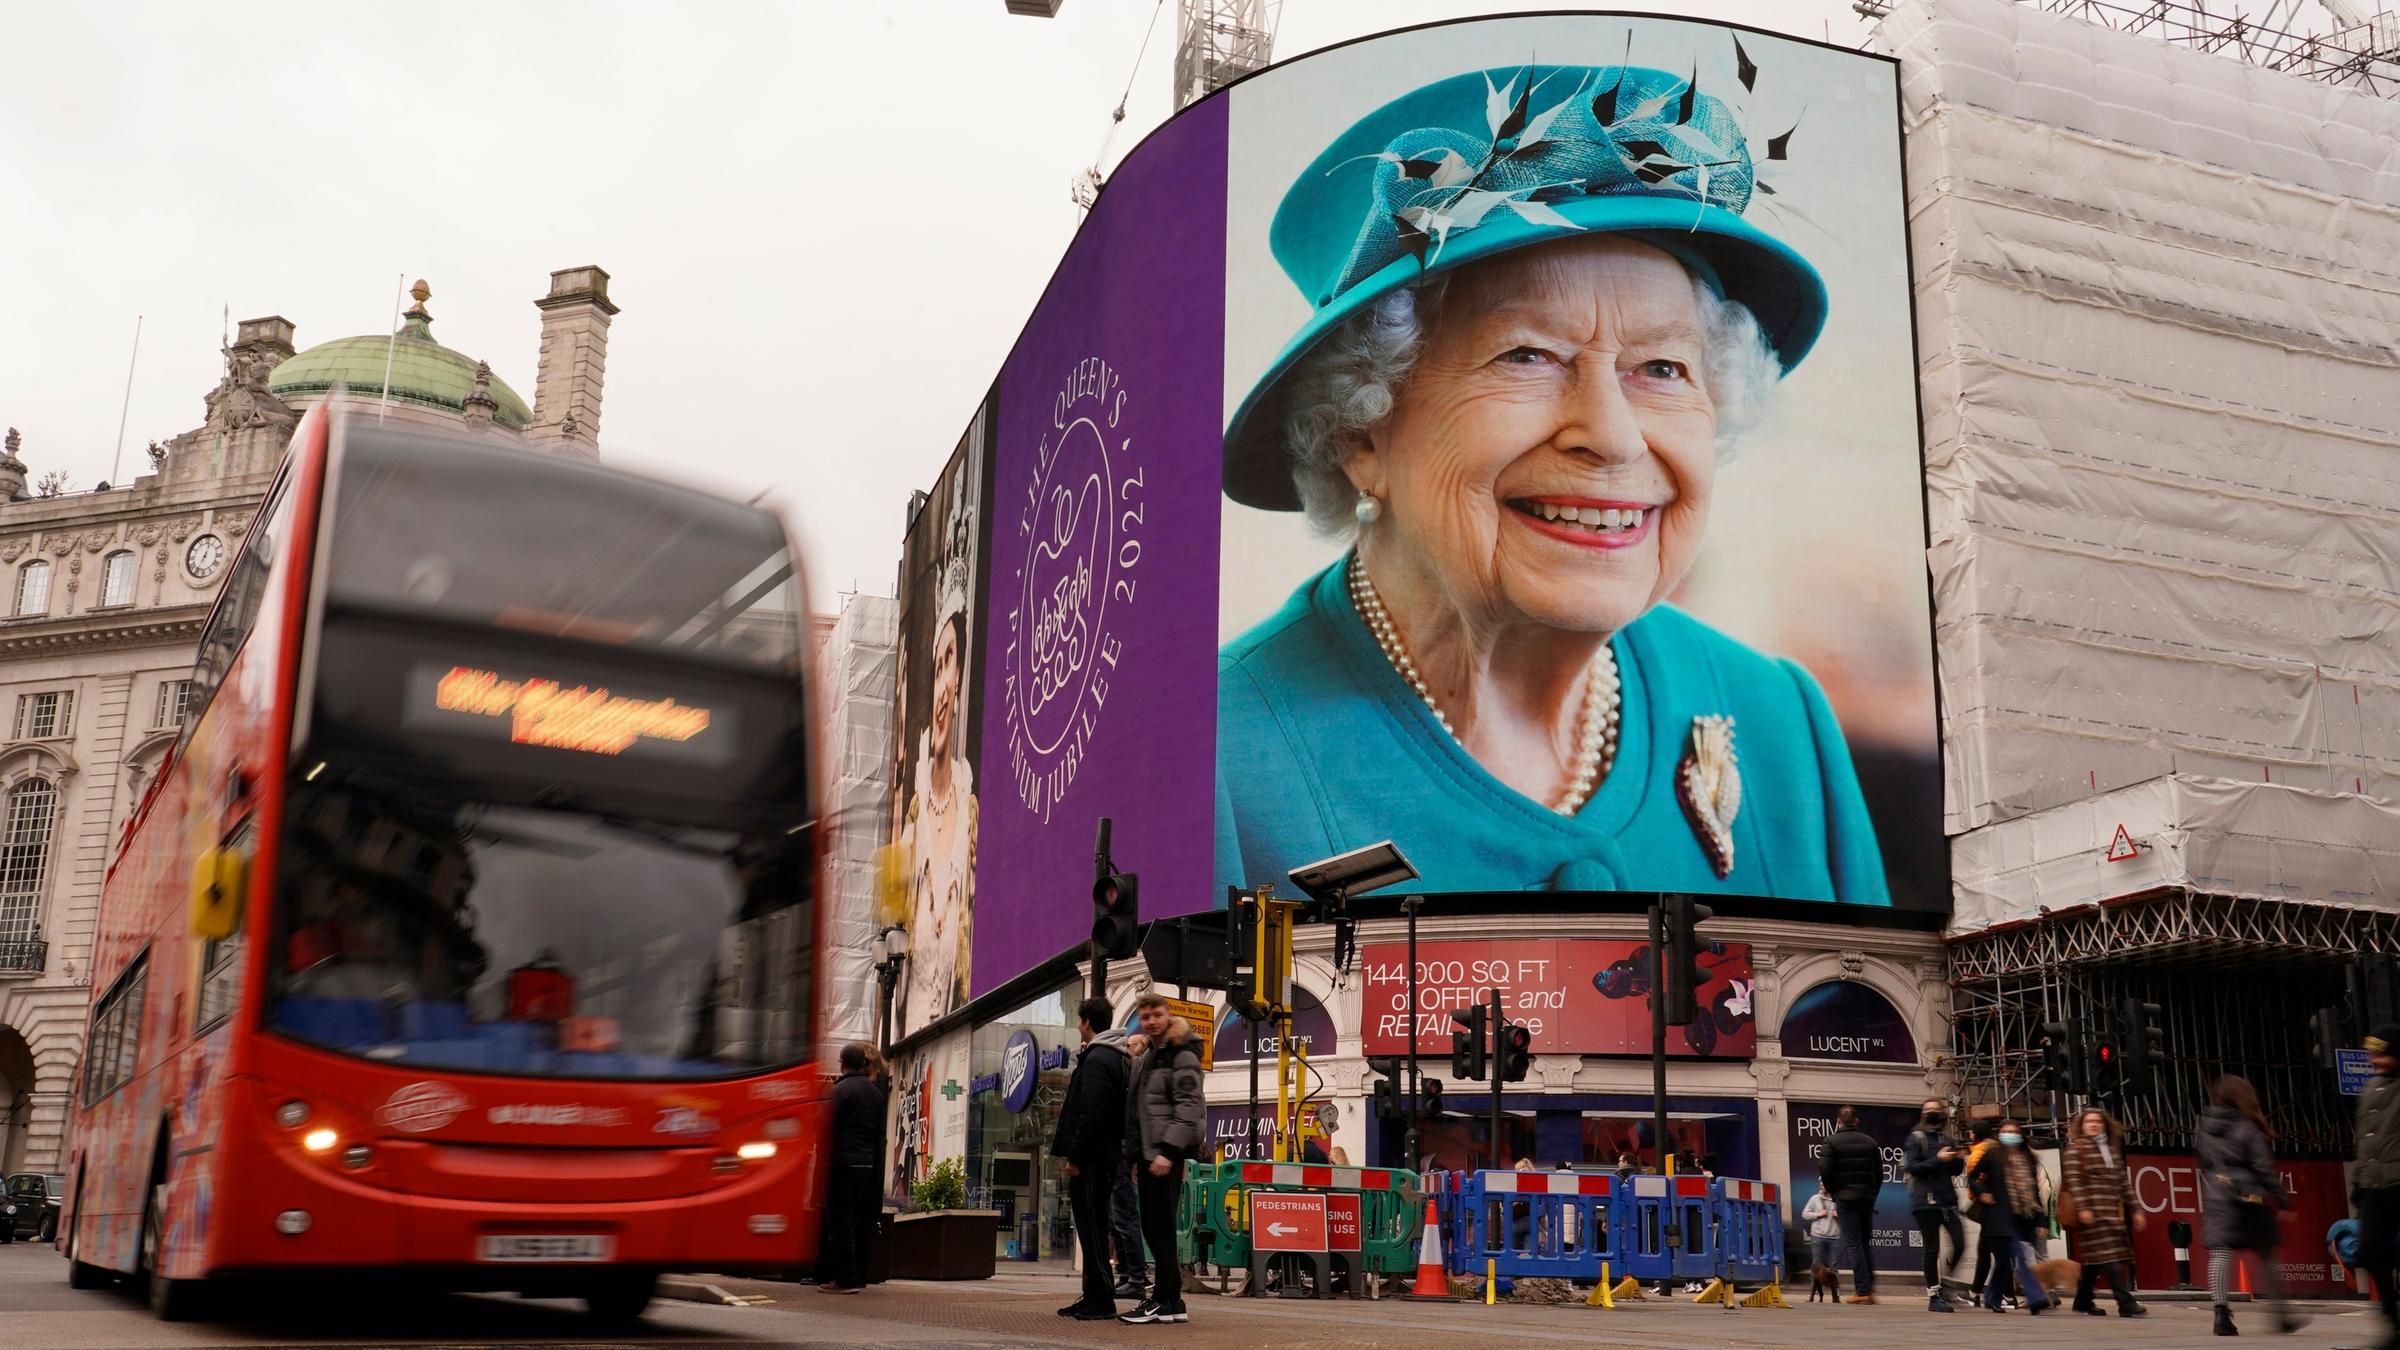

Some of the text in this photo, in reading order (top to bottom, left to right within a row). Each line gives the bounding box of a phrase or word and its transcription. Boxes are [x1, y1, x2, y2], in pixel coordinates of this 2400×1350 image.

[1019, 356, 1128, 537] THE QUEEN'S
[1006, 466, 1144, 825] PLATINUM JUBILEE 2022
[1363, 959, 1550, 989] 144,000 SQ FT
[1420, 986, 1512, 1011] OFFICE
[1518, 986, 1567, 1009] and
[1809, 1035, 1885, 1053] LUCENT W1
[1002, 1042, 1030, 1100] Boots
[1256, 1201, 1321, 1211] PEDESTRIANS
[1334, 1224, 1356, 1234] USE
